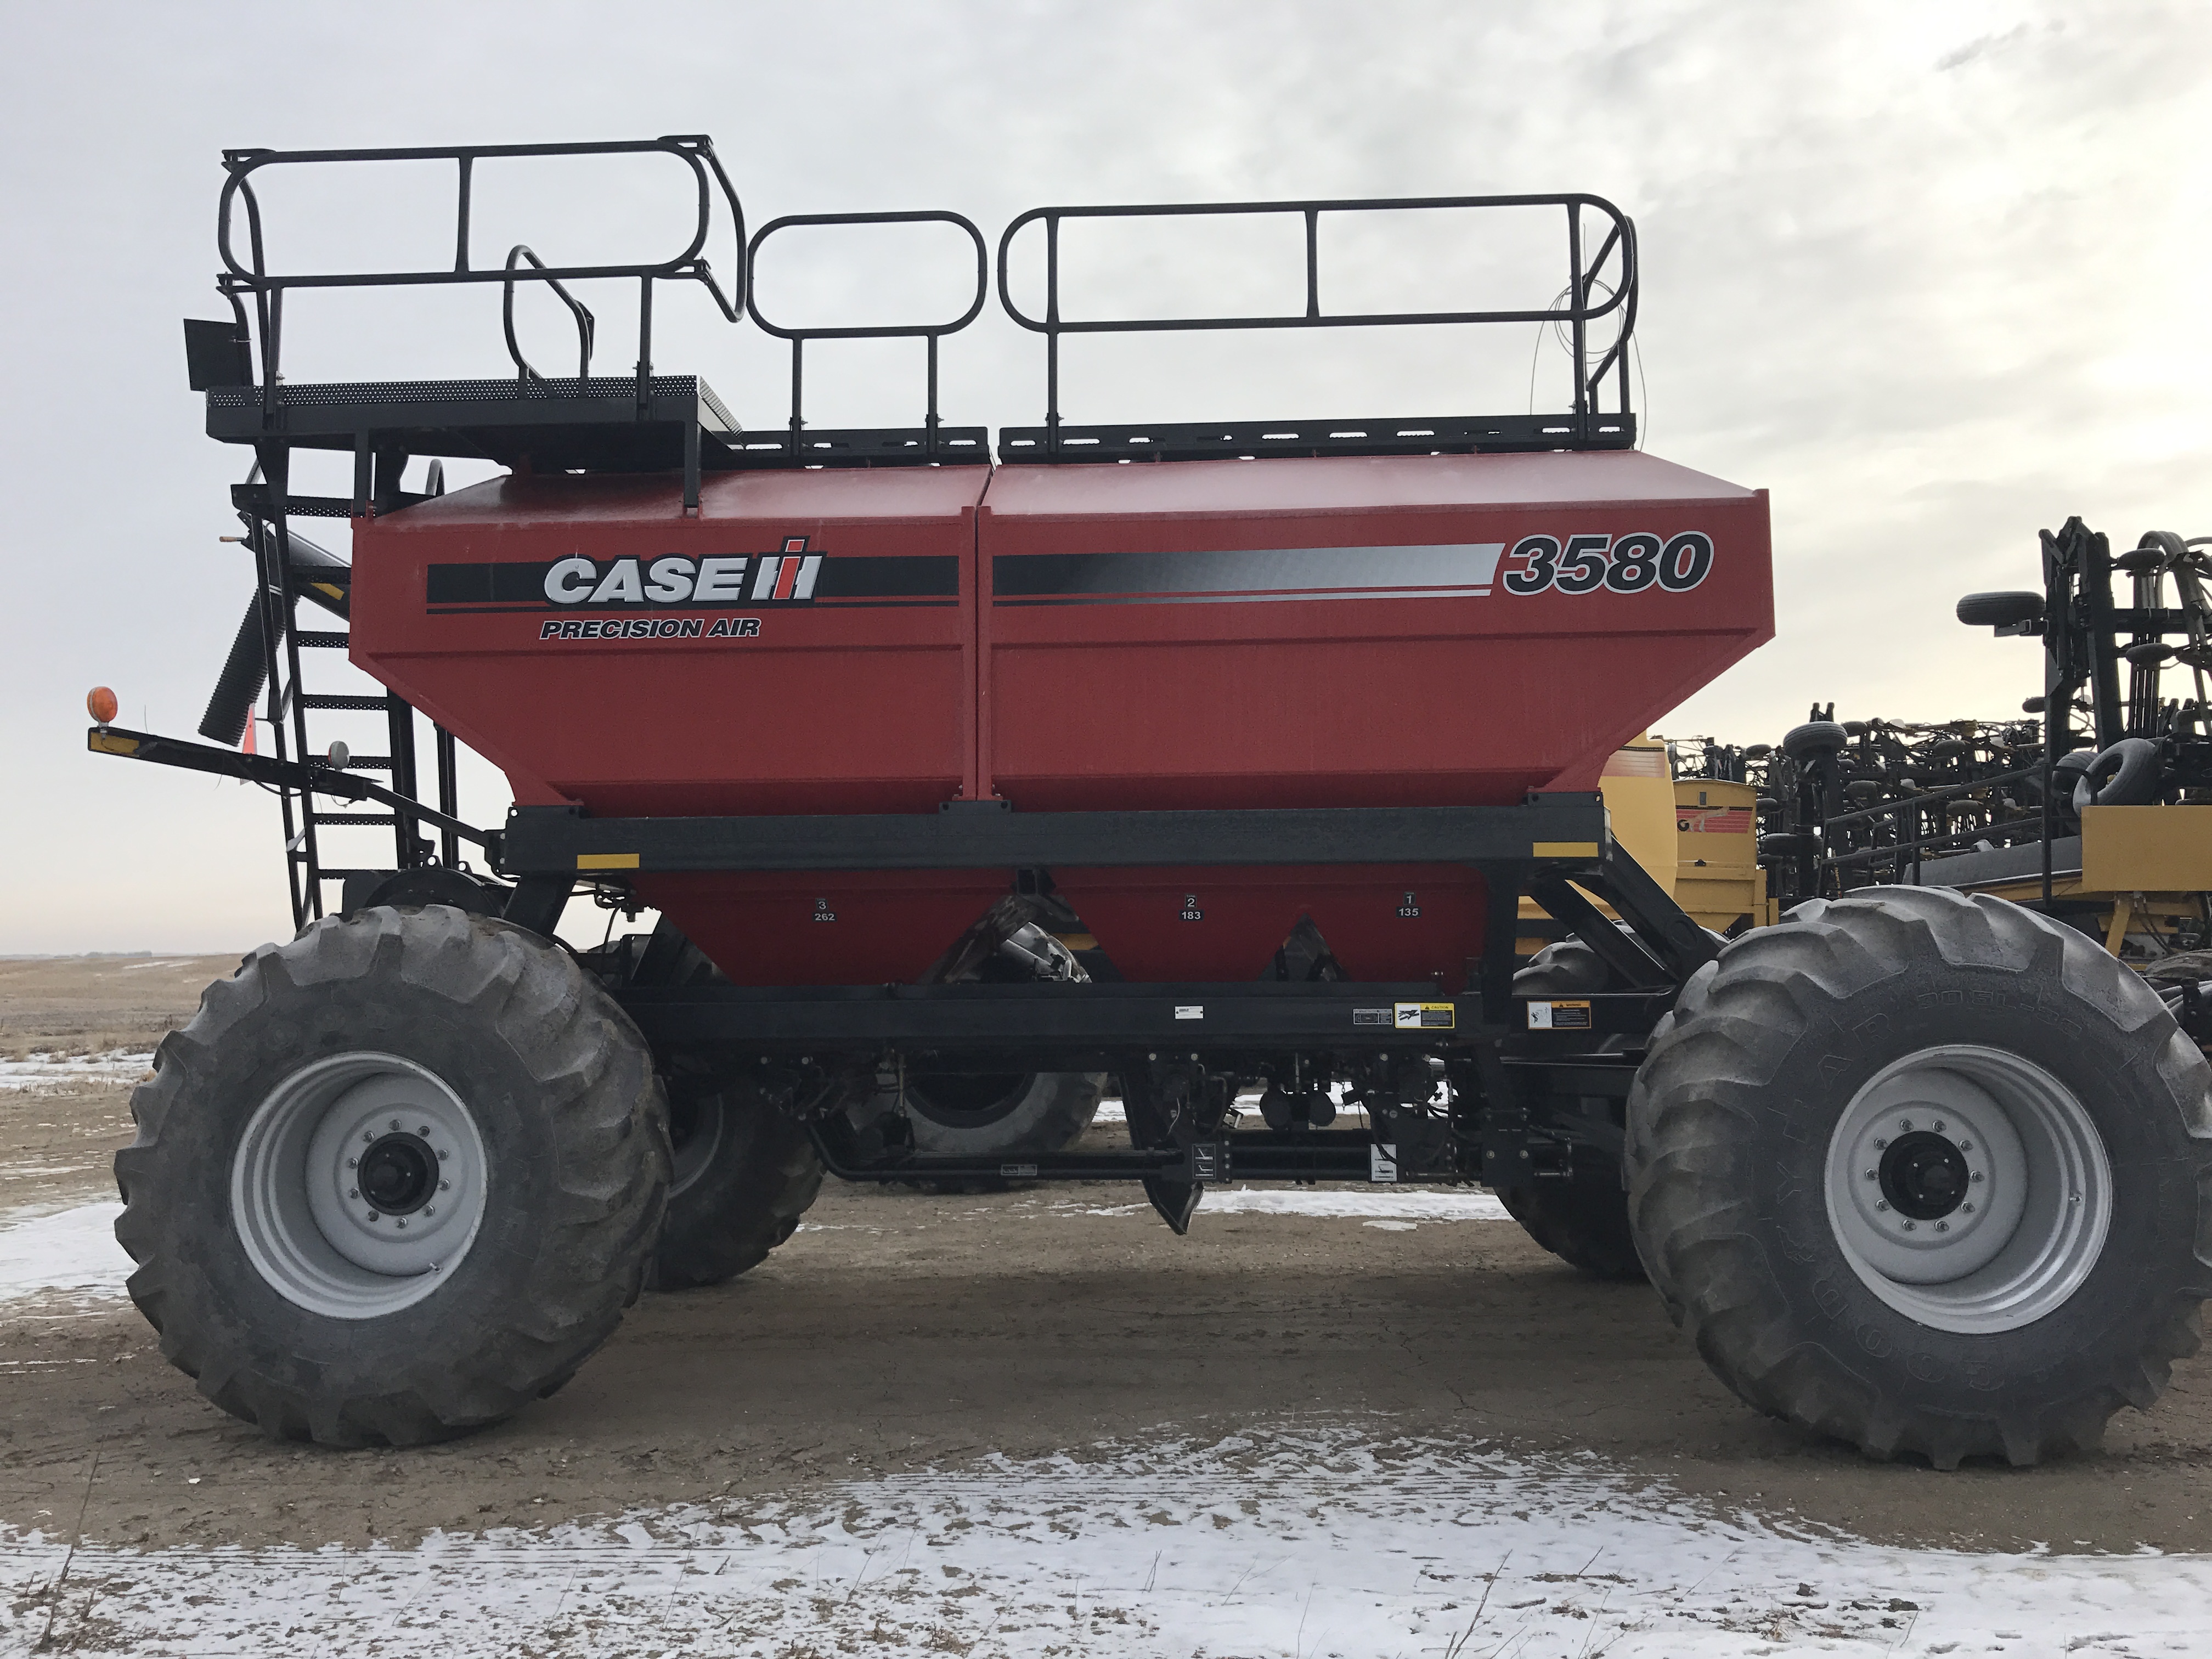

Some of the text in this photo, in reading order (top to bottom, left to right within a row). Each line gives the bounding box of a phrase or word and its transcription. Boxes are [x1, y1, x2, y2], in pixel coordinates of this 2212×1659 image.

[1503, 531, 1714, 596] 3580
[544, 557, 748, 603] CASE
[540, 618, 762, 640] PRECISION AIR
[1187, 898, 1195, 907] 2
[1406, 895, 1412, 904] 1
[818, 901, 827, 910] 3
[1182, 911, 1201, 919] 183
[1399, 908, 1419, 916] 135
